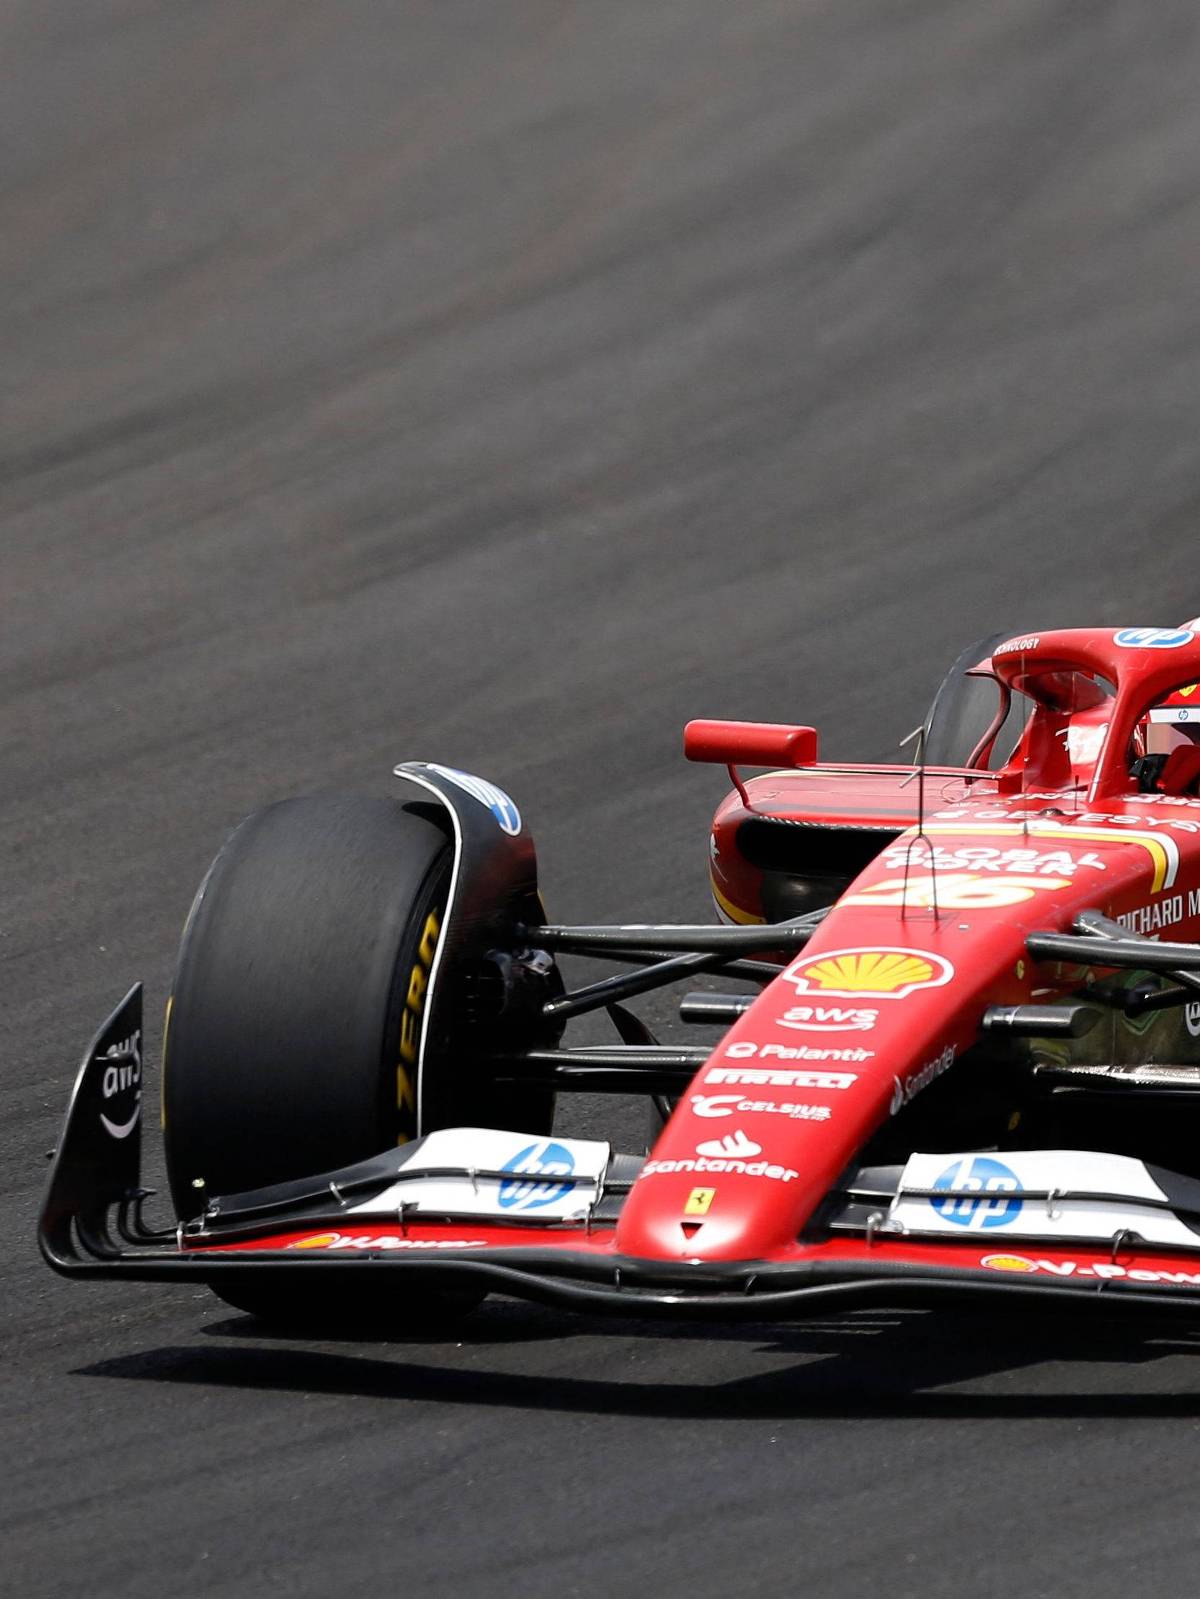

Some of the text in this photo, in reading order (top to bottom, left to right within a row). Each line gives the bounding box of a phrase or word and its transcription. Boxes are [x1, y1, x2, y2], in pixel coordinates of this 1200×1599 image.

[882, 847, 1107, 870] GLOBAL
[886, 857, 1077, 876] POKER
[782, 1006, 879, 1024] aws
[759, 1043, 876, 1062] Palantir
[704, 1067, 859, 1090] PIRELLI
[736, 1100, 832, 1117] CELSIUS
[501, 1142, 574, 1209] hp
[940, 1158, 1019, 1227] hp
